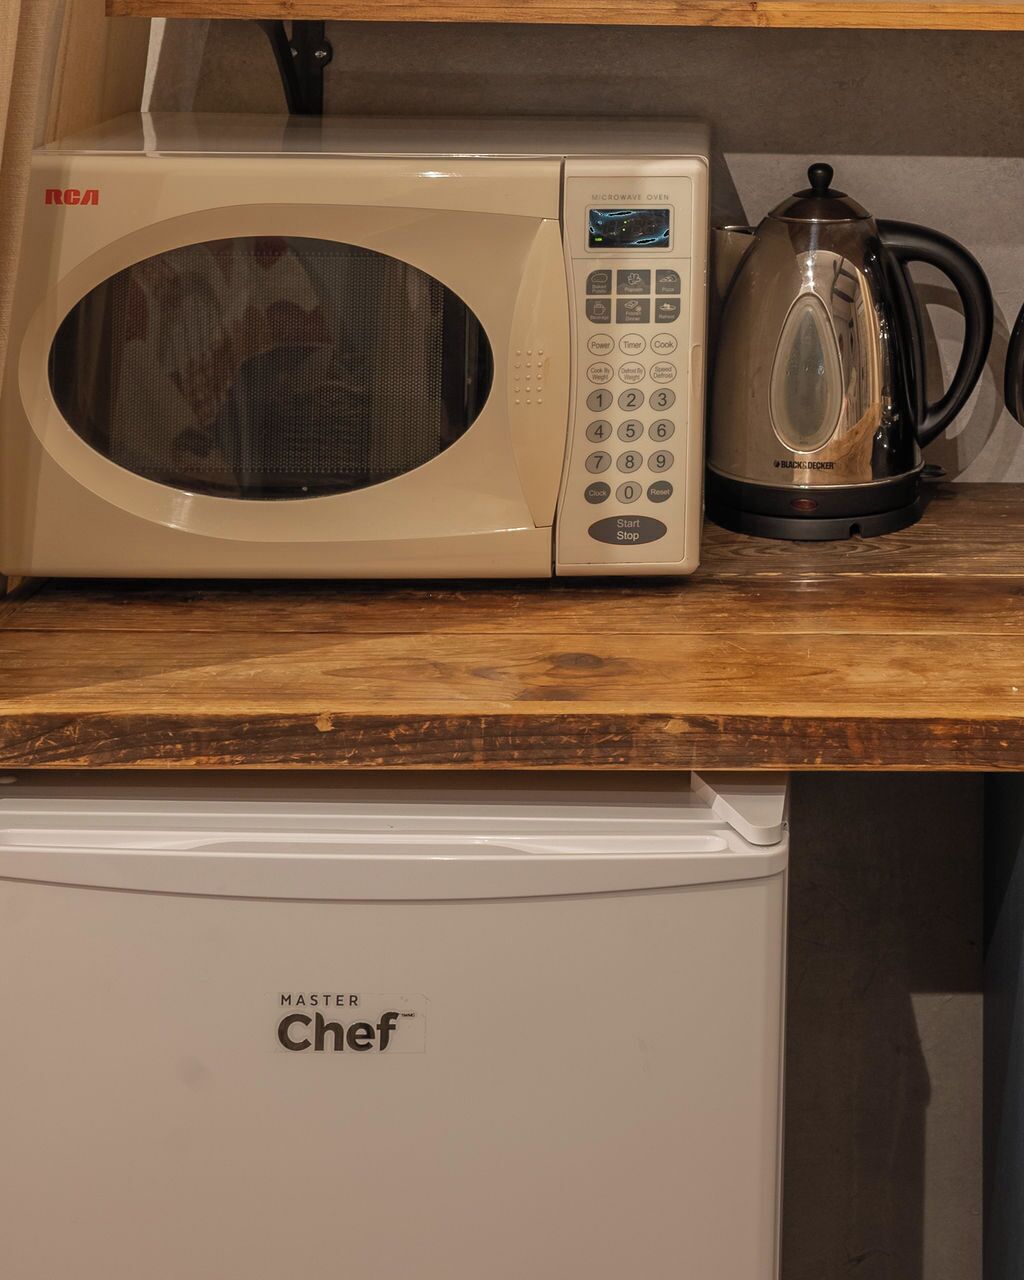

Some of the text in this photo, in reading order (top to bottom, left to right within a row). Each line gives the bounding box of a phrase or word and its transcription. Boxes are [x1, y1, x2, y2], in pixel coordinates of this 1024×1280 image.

[45, 189, 99, 206] RCA
[591, 341, 611, 350] Power
[624, 341, 642, 349] Timer
[654, 340, 674, 349] Cook
[597, 394, 602, 407] 1
[626, 393, 636, 407] 2
[658, 392, 667, 406] 3
[594, 425, 604, 438] 4
[626, 424, 635, 437] 5
[657, 424, 666, 437] 6
[594, 456, 603, 469] 7
[625, 455, 634, 468] 8
[656, 455, 666, 468] 9
[589, 489, 607, 497] Clock
[624, 486, 633, 499] 0
[617, 519, 640, 528] Start
[617, 531, 640, 541] Stop
[280, 994, 359, 1007] MASTER
[277, 1011, 399, 1052] Chef
